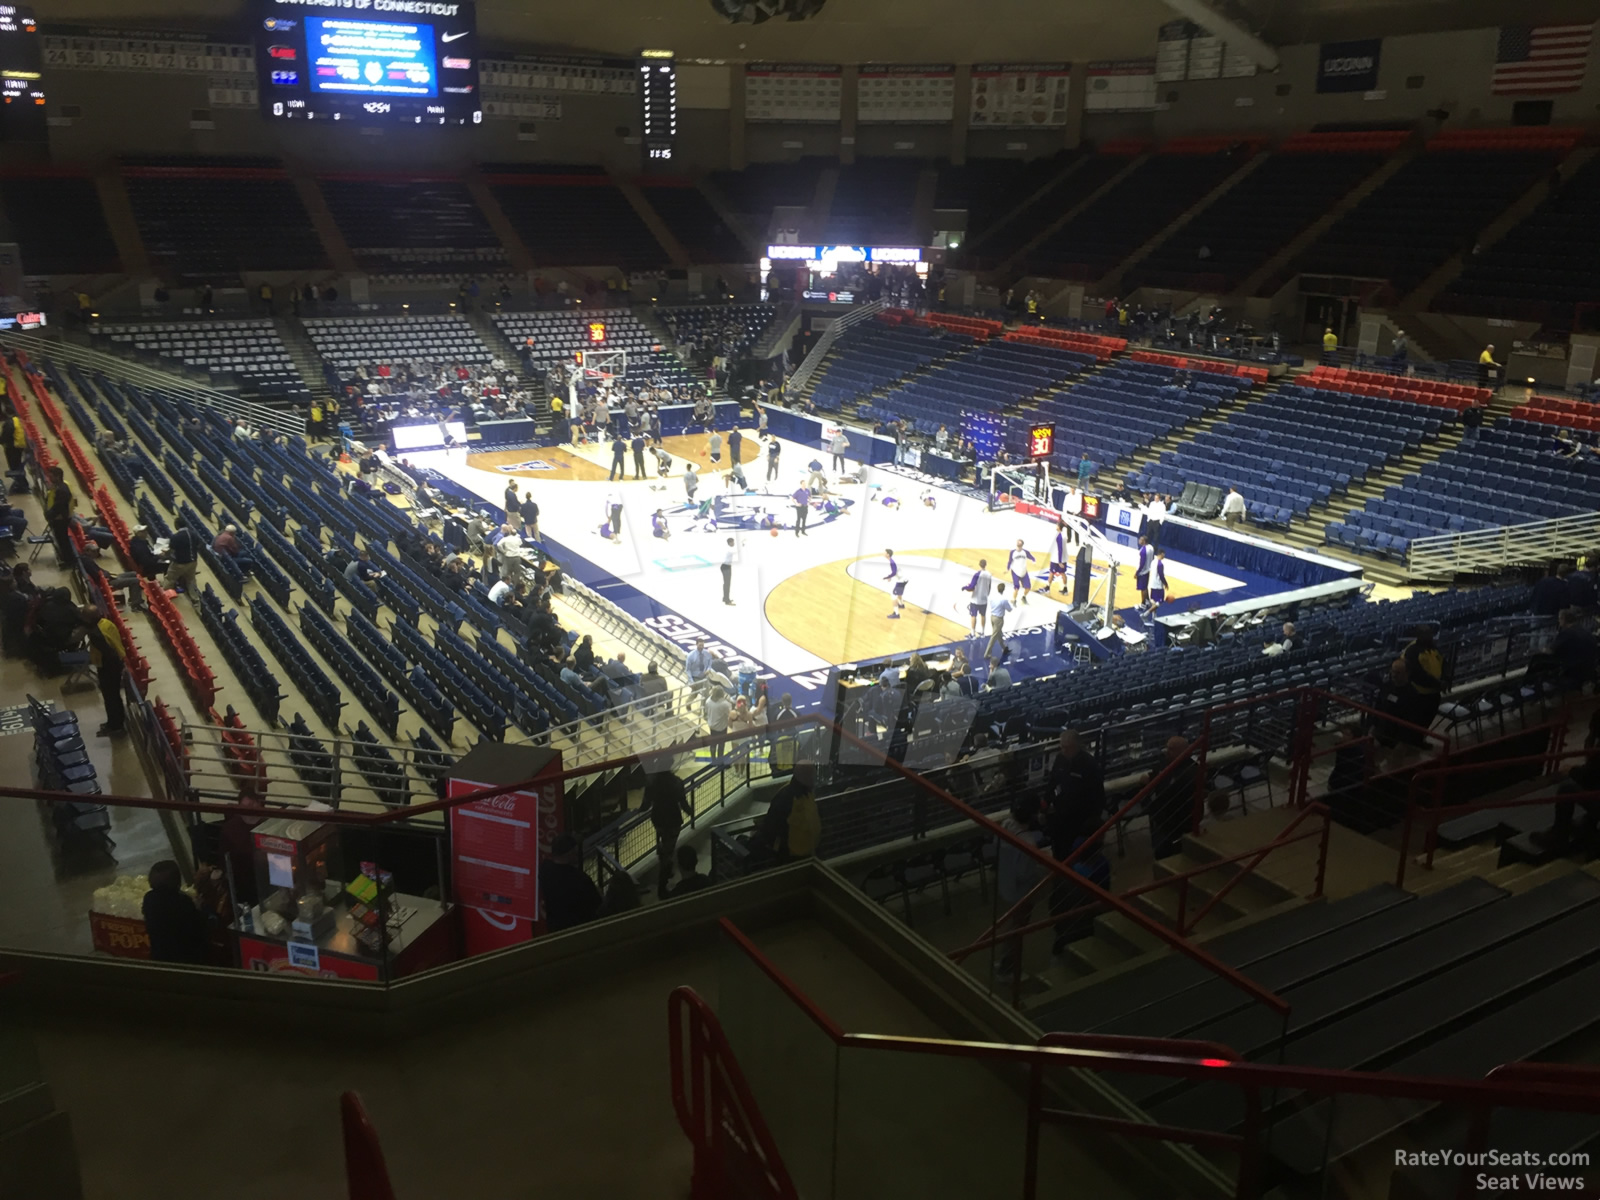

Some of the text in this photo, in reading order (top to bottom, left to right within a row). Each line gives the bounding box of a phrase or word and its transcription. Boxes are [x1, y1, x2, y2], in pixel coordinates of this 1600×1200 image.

[374, 1, 460, 16] CONNECTICUT
[131, 54, 147, 66] 52
[1033, 438, 1049, 455] 30
